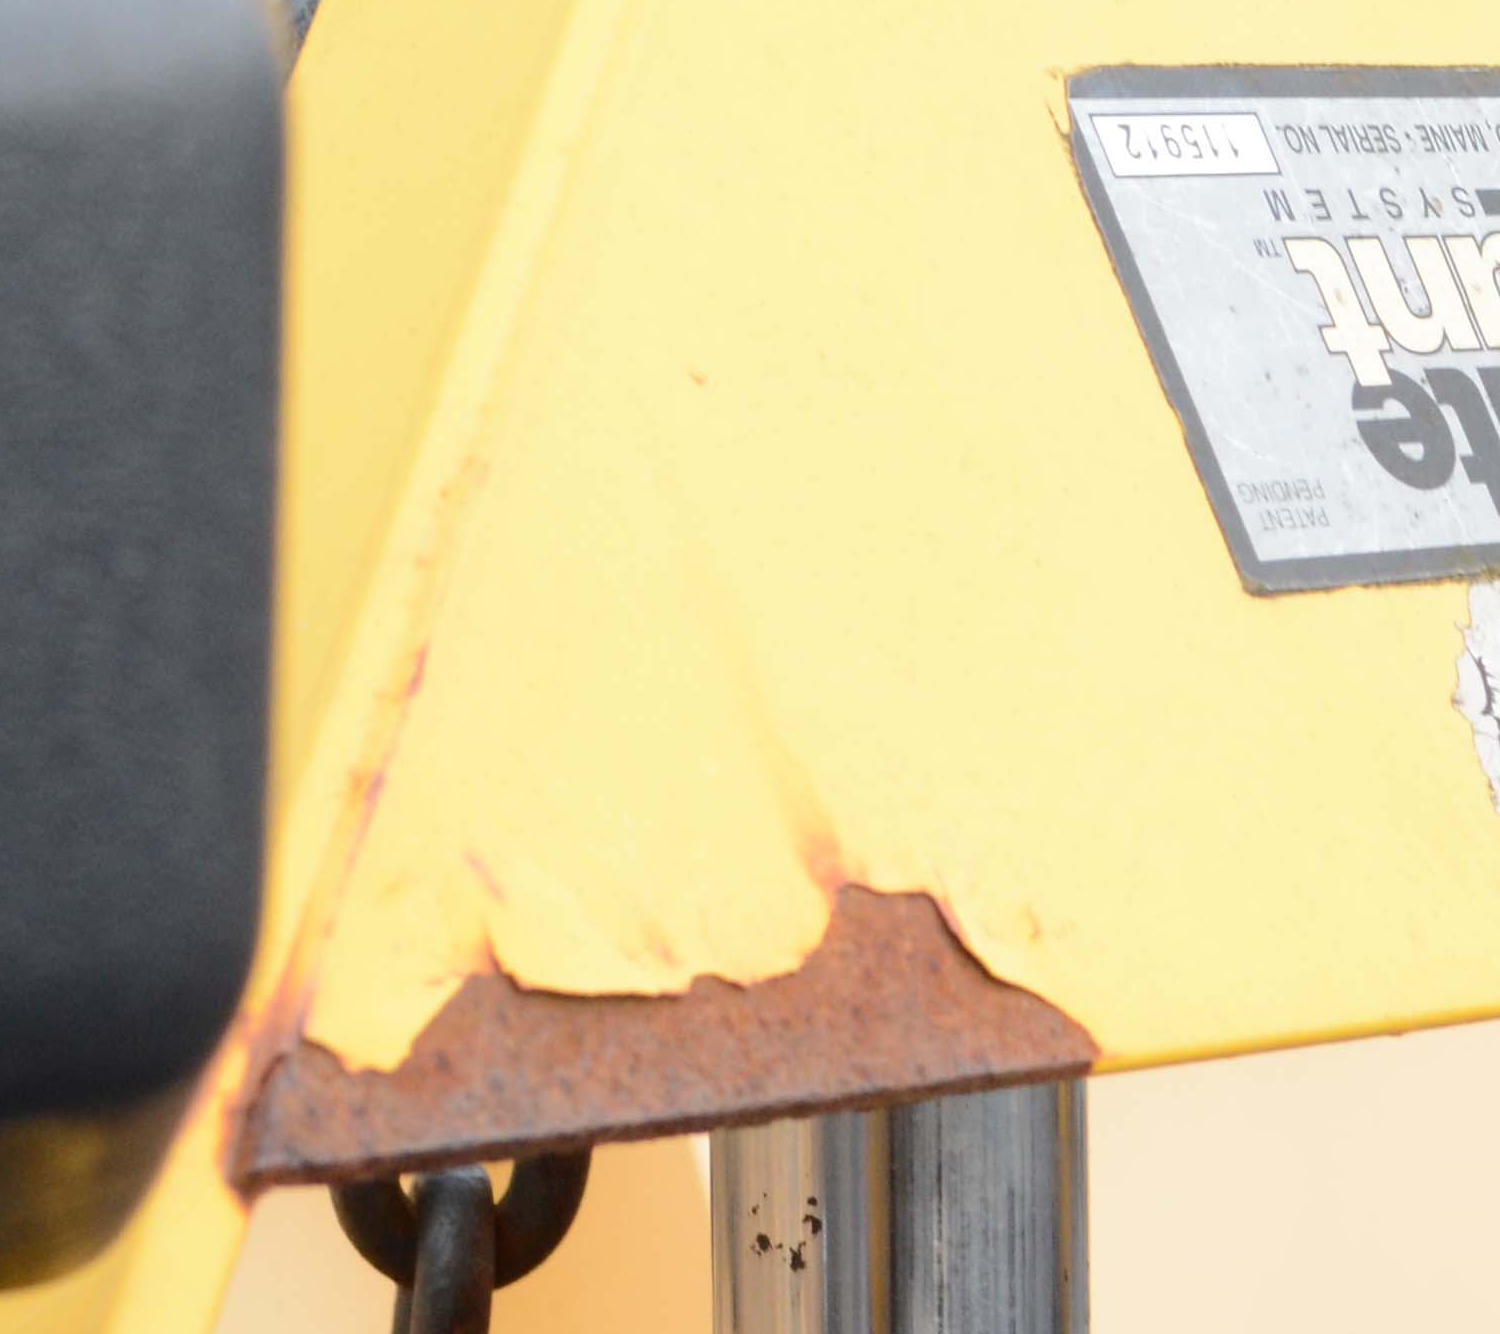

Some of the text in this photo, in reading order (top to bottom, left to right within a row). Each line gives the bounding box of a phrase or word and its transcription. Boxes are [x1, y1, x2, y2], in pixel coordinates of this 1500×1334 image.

[1116, 123, 1240, 159] 115912
[1275, 125, 1316, 154] NO.
[1323, 124, 1401, 154] SERIAL
[1414, 124, 1489, 153] MAINE
[1261, 187, 1476, 221] SYSTEM
[1236, 479, 1327, 504] PENDING
[1258, 507, 1332, 531] PATENT
